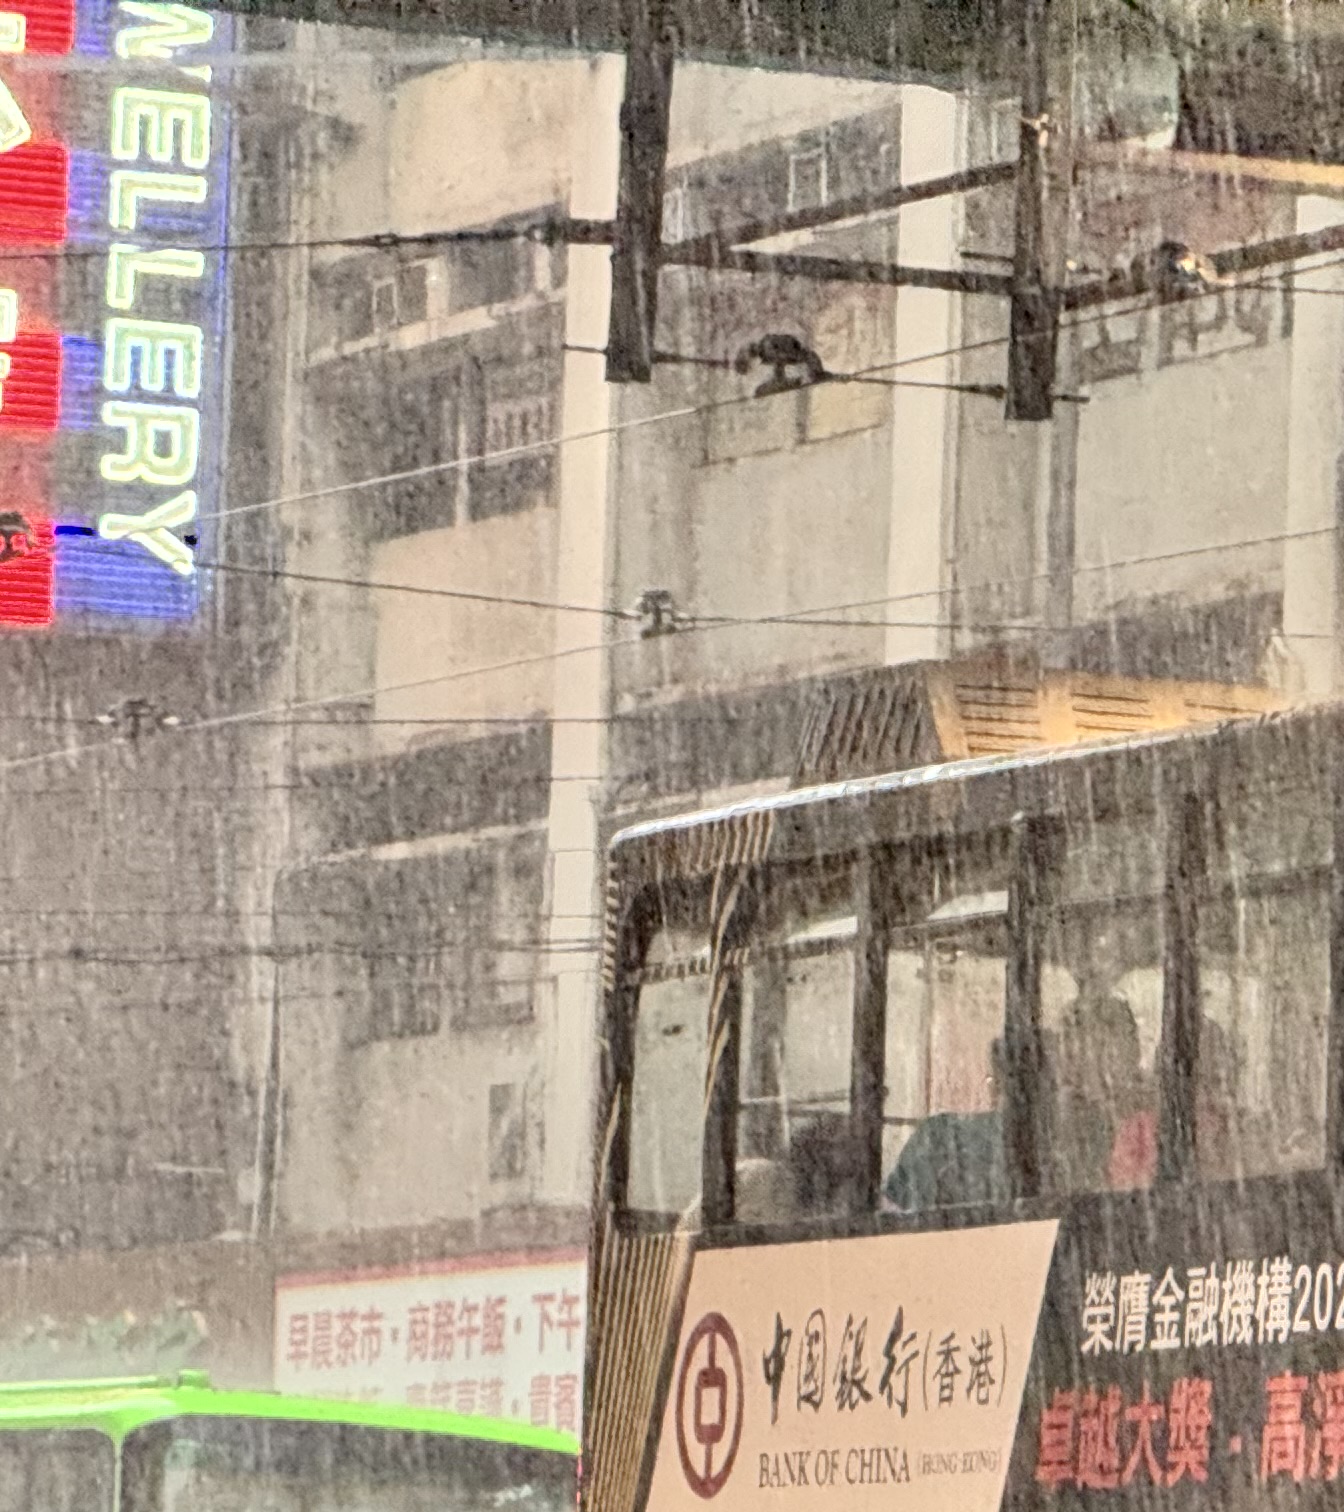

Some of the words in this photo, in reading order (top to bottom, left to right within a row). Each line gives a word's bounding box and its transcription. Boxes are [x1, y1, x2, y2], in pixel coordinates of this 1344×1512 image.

[762, 1305, 1009, 1425] 中國銀行(香港)
[758, 1450, 811, 1488] BANK
[814, 1448, 840, 1487] OF
[845, 1446, 910, 1485] CHINA
